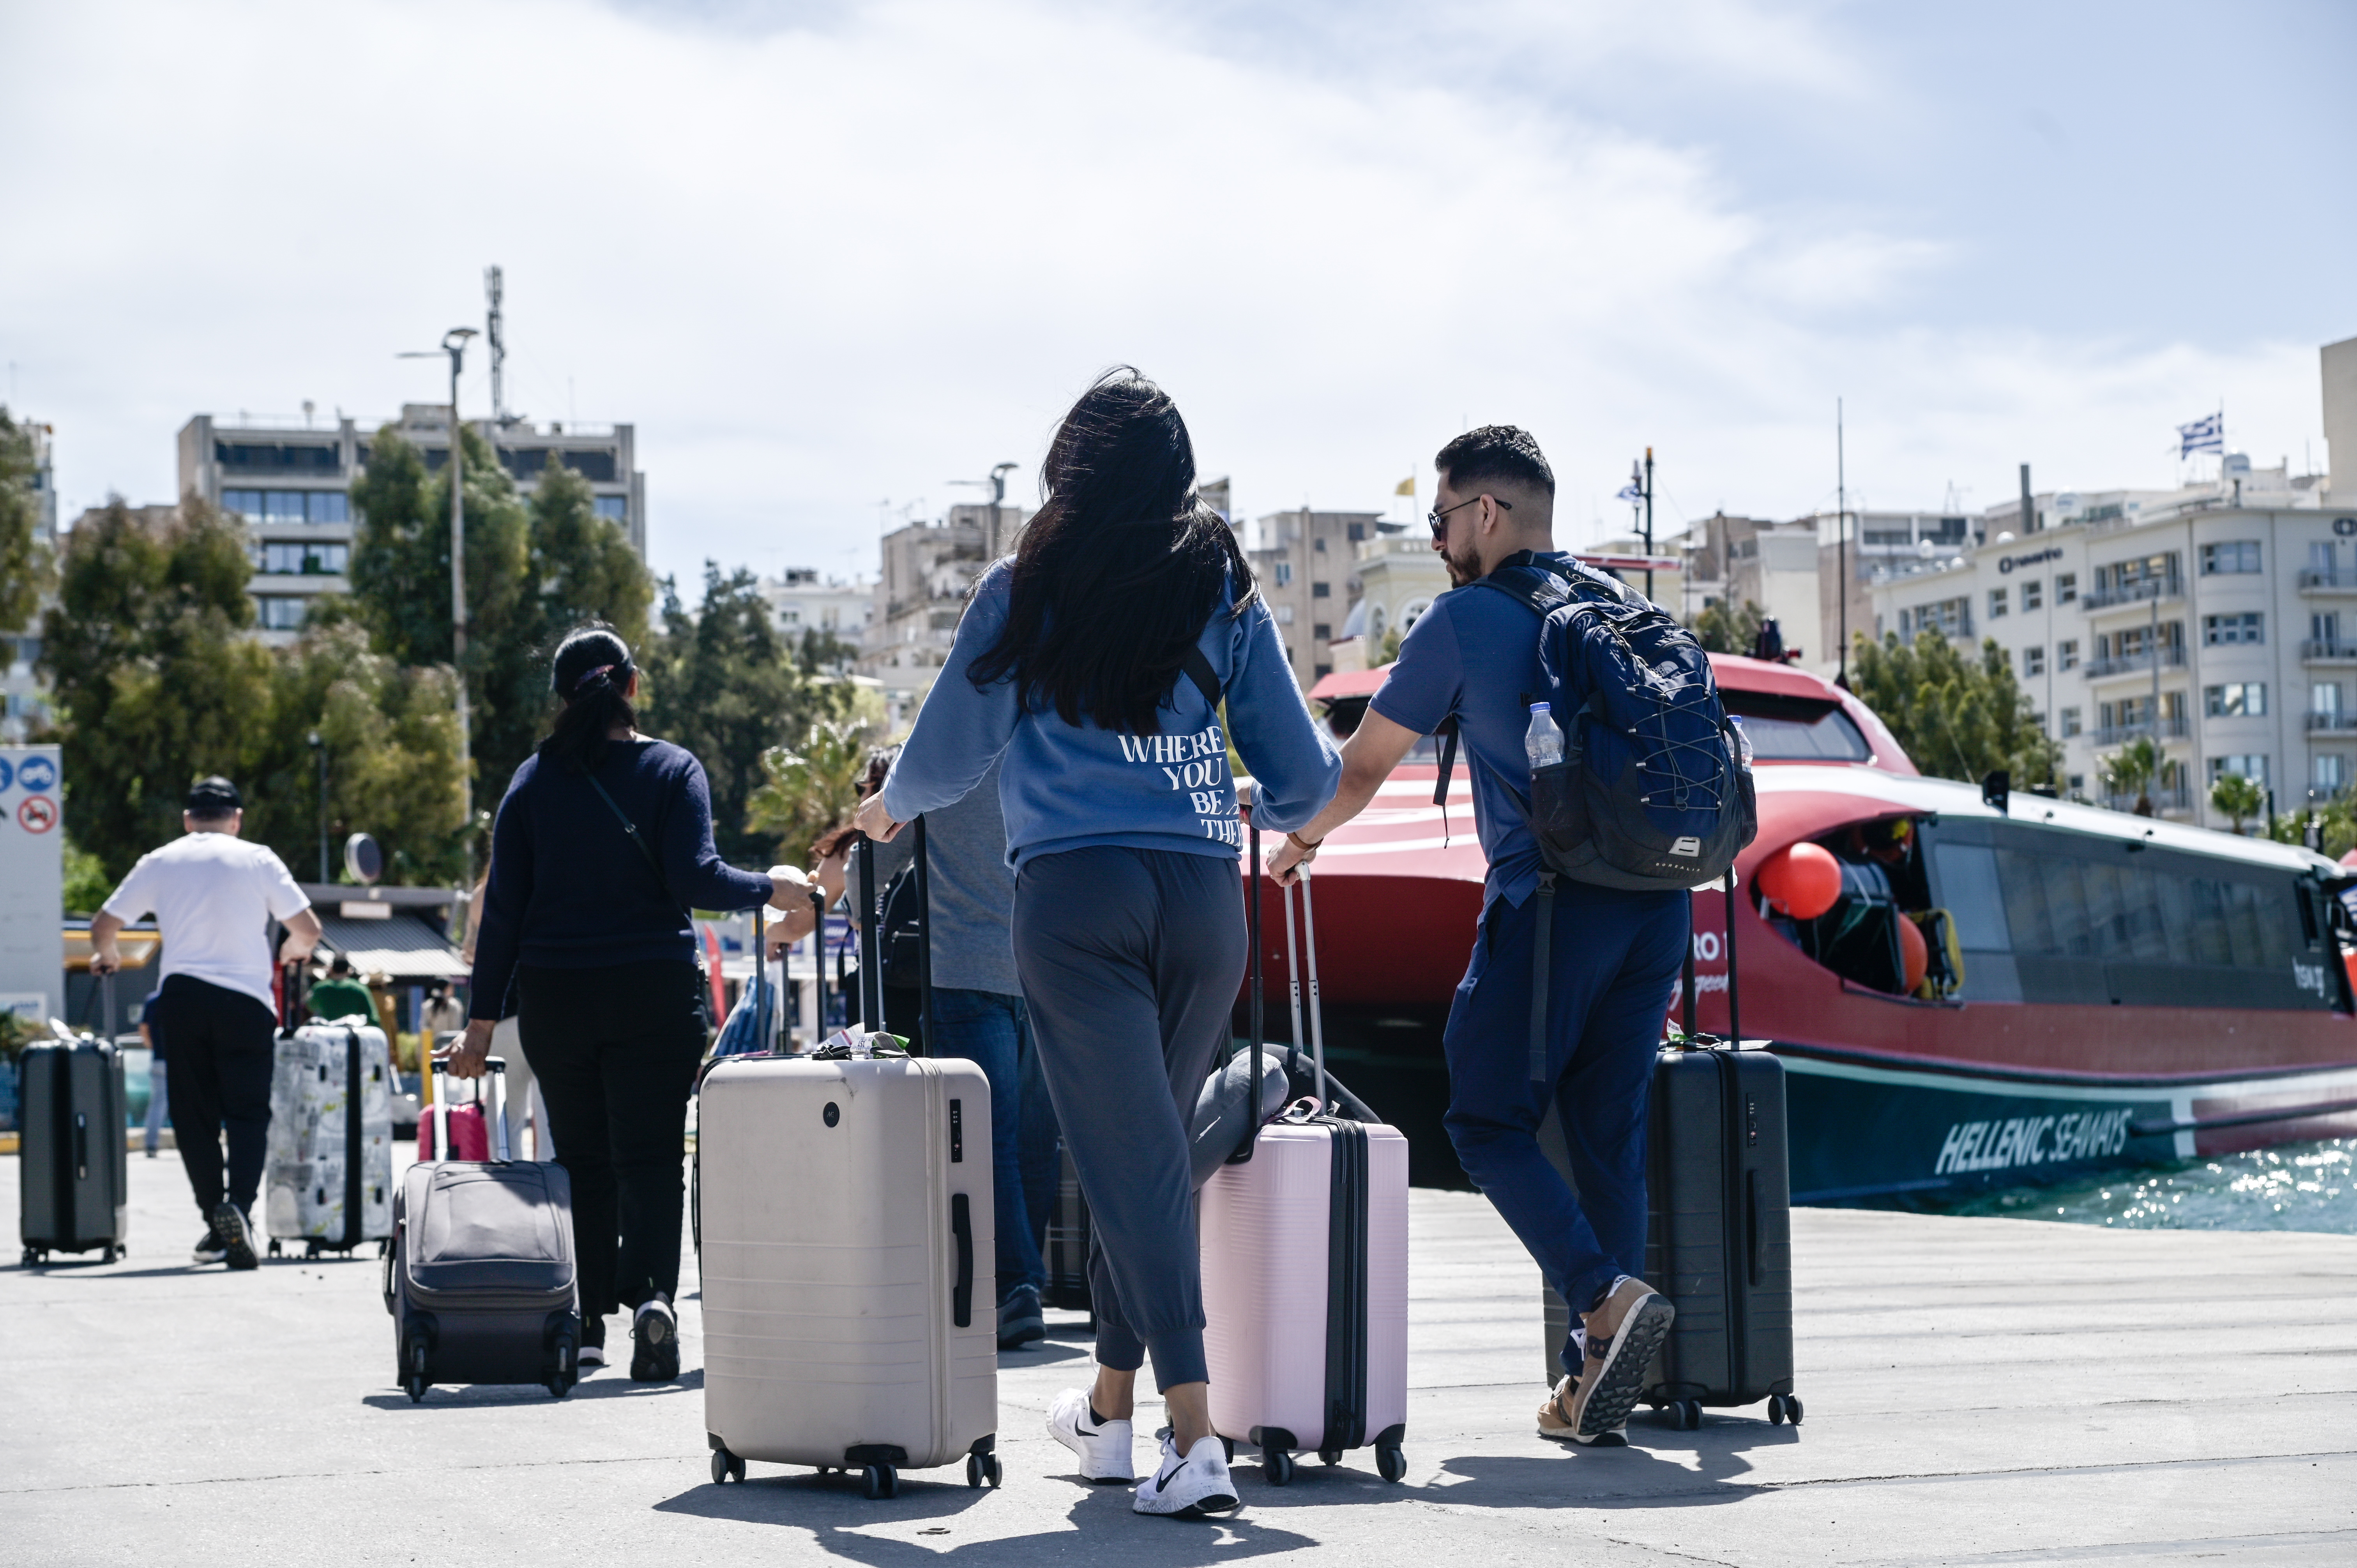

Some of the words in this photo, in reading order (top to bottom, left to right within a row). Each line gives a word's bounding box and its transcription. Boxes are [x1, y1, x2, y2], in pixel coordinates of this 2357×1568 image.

[1117, 726, 1226, 763] WHERE
[1162, 758, 1222, 790] YOU
[1189, 789, 1224, 815] BE
[1226, 794, 1240, 815] A
[1656, 862, 1700, 872] BOREALIS
[1934, 1115, 2055, 1175] HELLENIC
[2048, 1108, 2133, 1162] SEAWAYS
